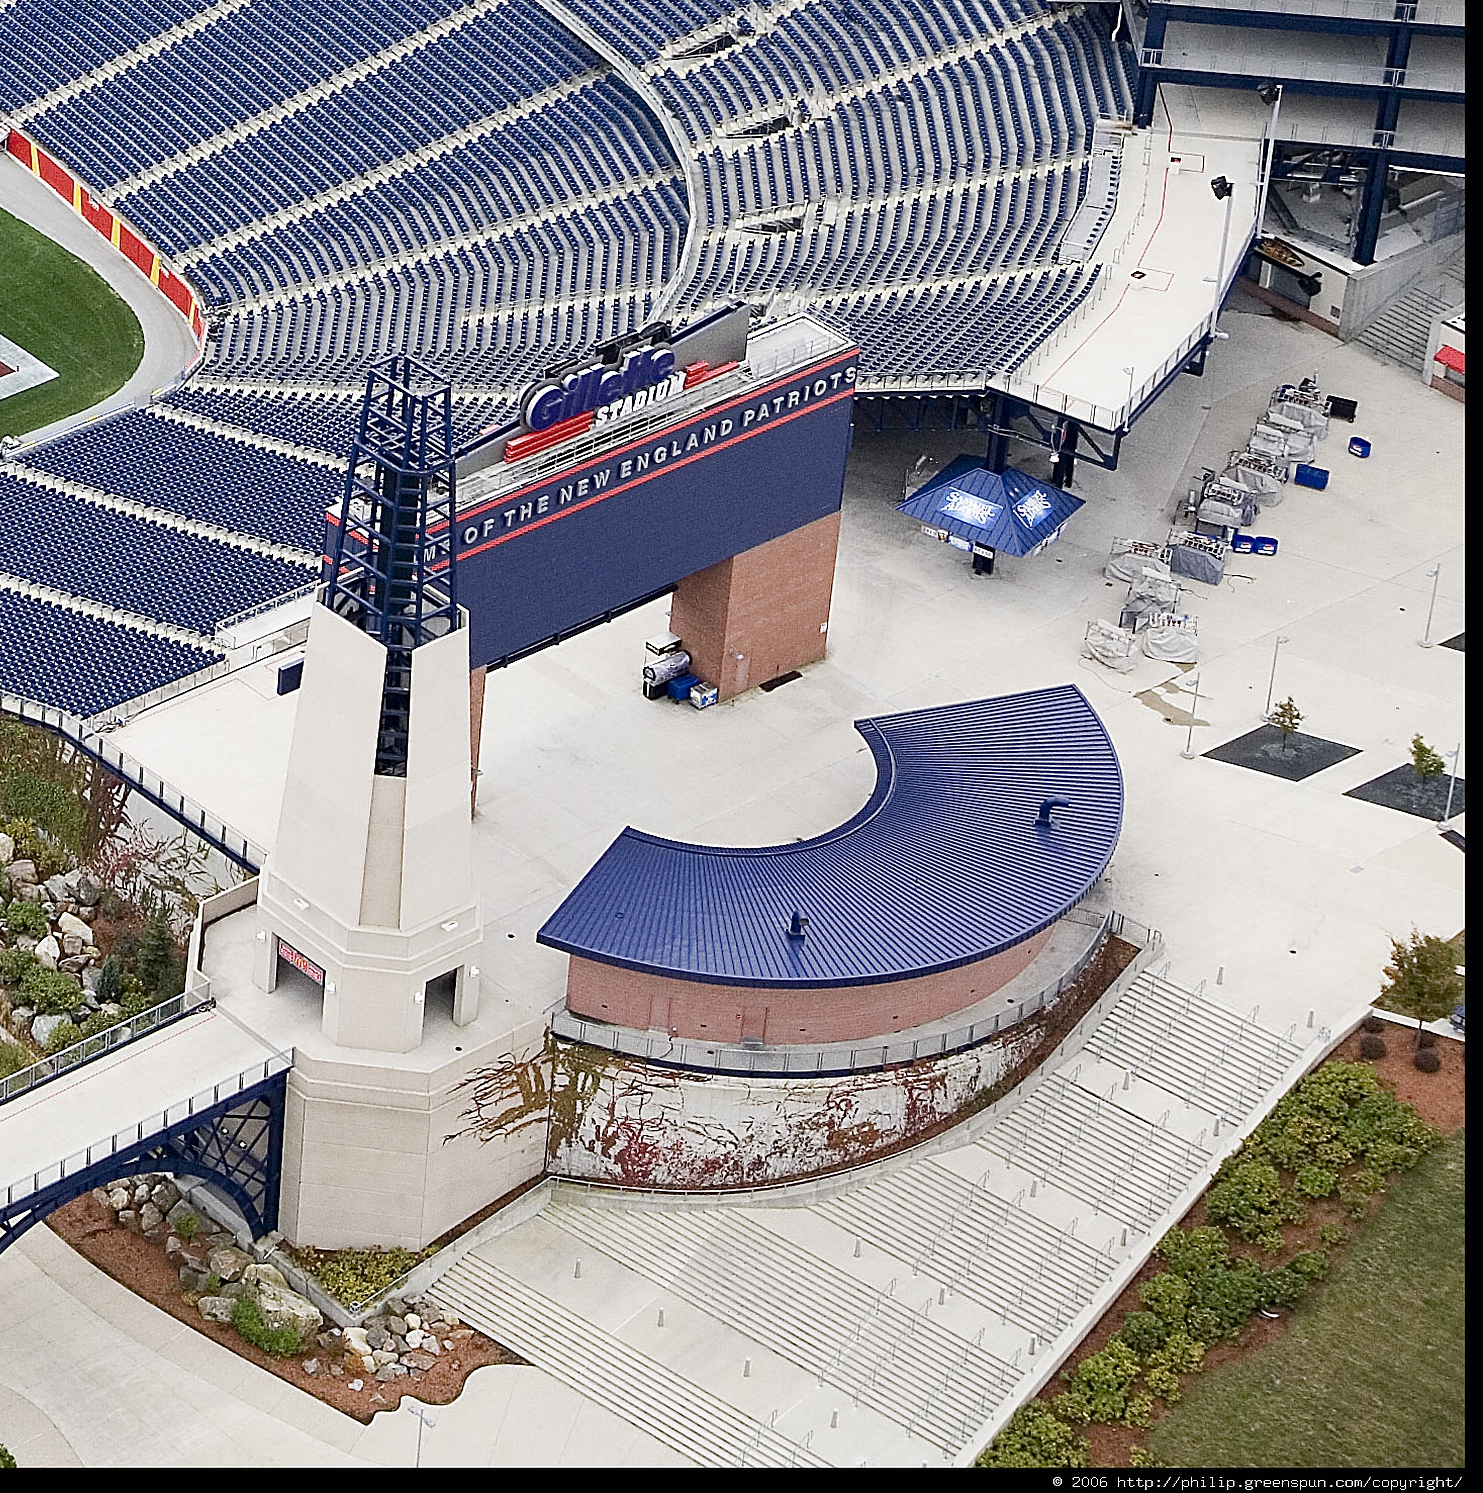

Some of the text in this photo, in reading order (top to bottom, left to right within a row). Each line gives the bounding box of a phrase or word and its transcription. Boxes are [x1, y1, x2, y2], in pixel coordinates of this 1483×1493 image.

[527, 345, 675, 431] Gillette
[595, 371, 686, 427] STADIUM
[463, 366, 858, 545] OF THE NEW ENGLAND PATRIOTS
[940, 504, 987, 525] ADAMS
[946, 491, 995, 518] SAMUEL
